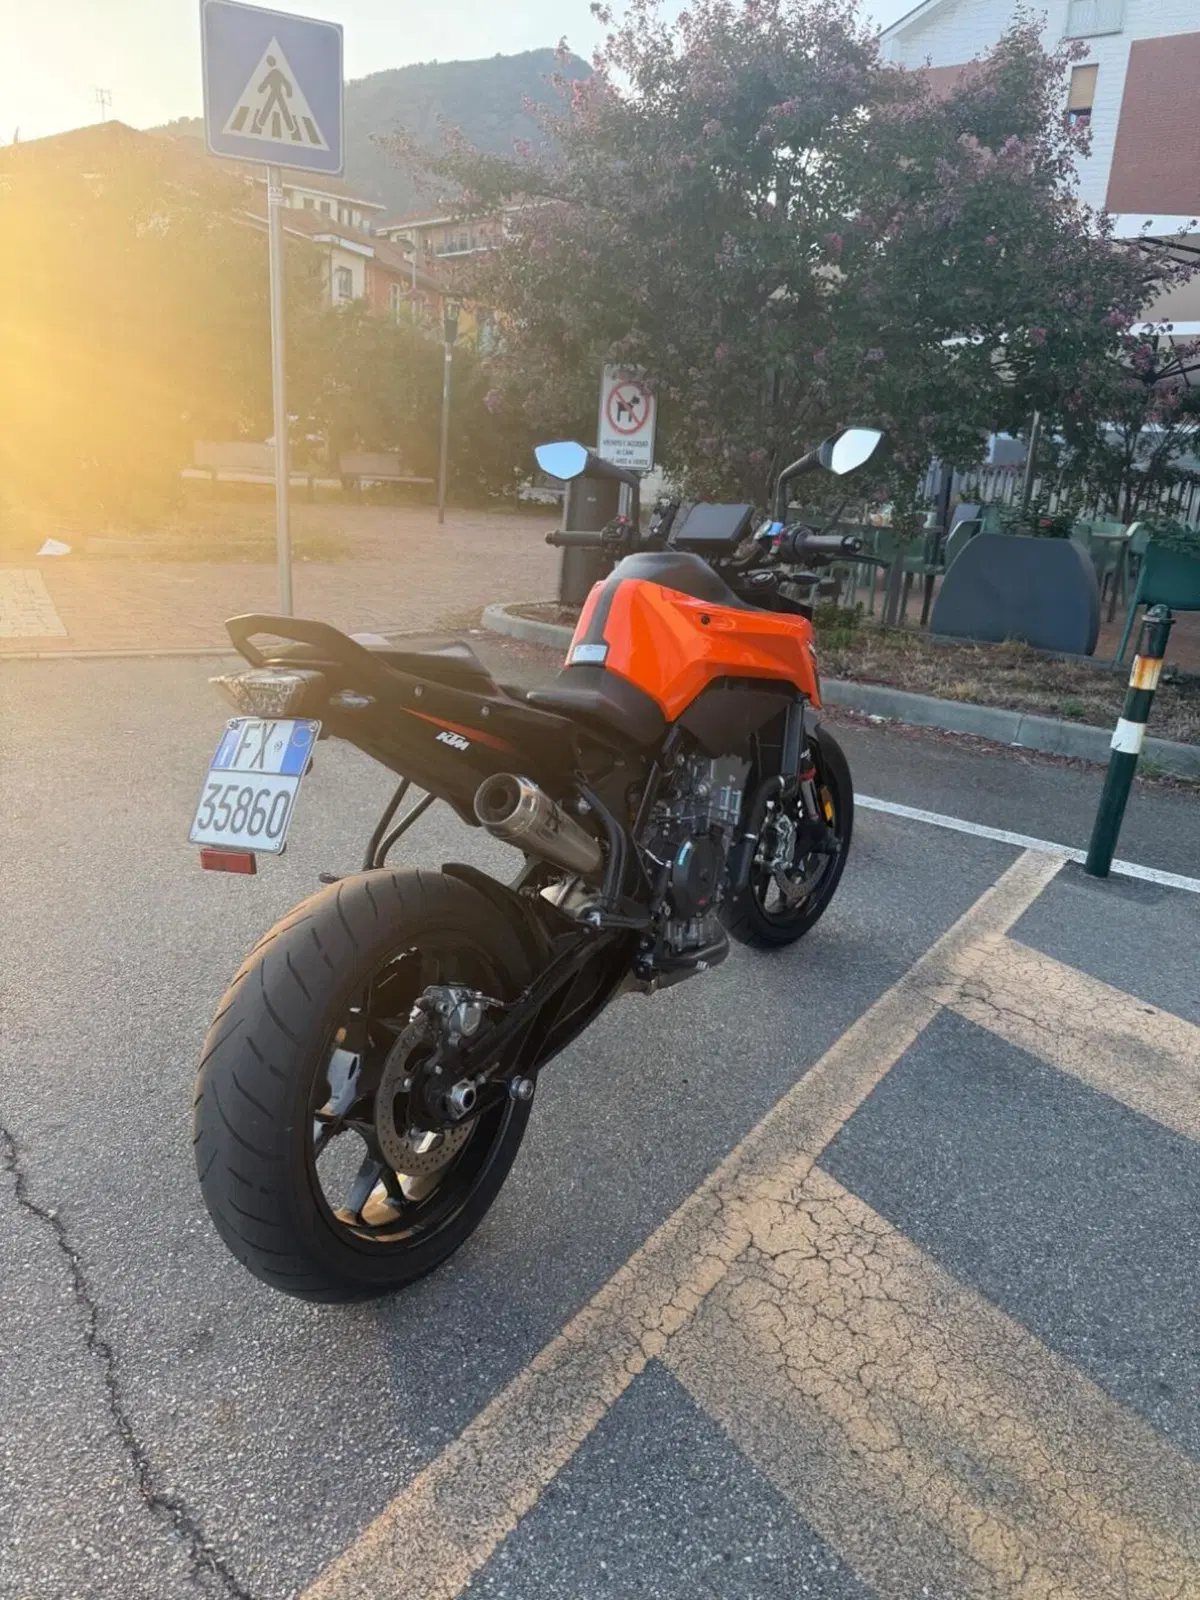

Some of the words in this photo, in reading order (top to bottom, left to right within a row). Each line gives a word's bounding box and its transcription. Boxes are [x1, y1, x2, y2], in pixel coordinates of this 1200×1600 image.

[232, 722, 277, 769] FX
[435, 731, 470, 751] KTM
[197, 783, 291, 838] 35860
